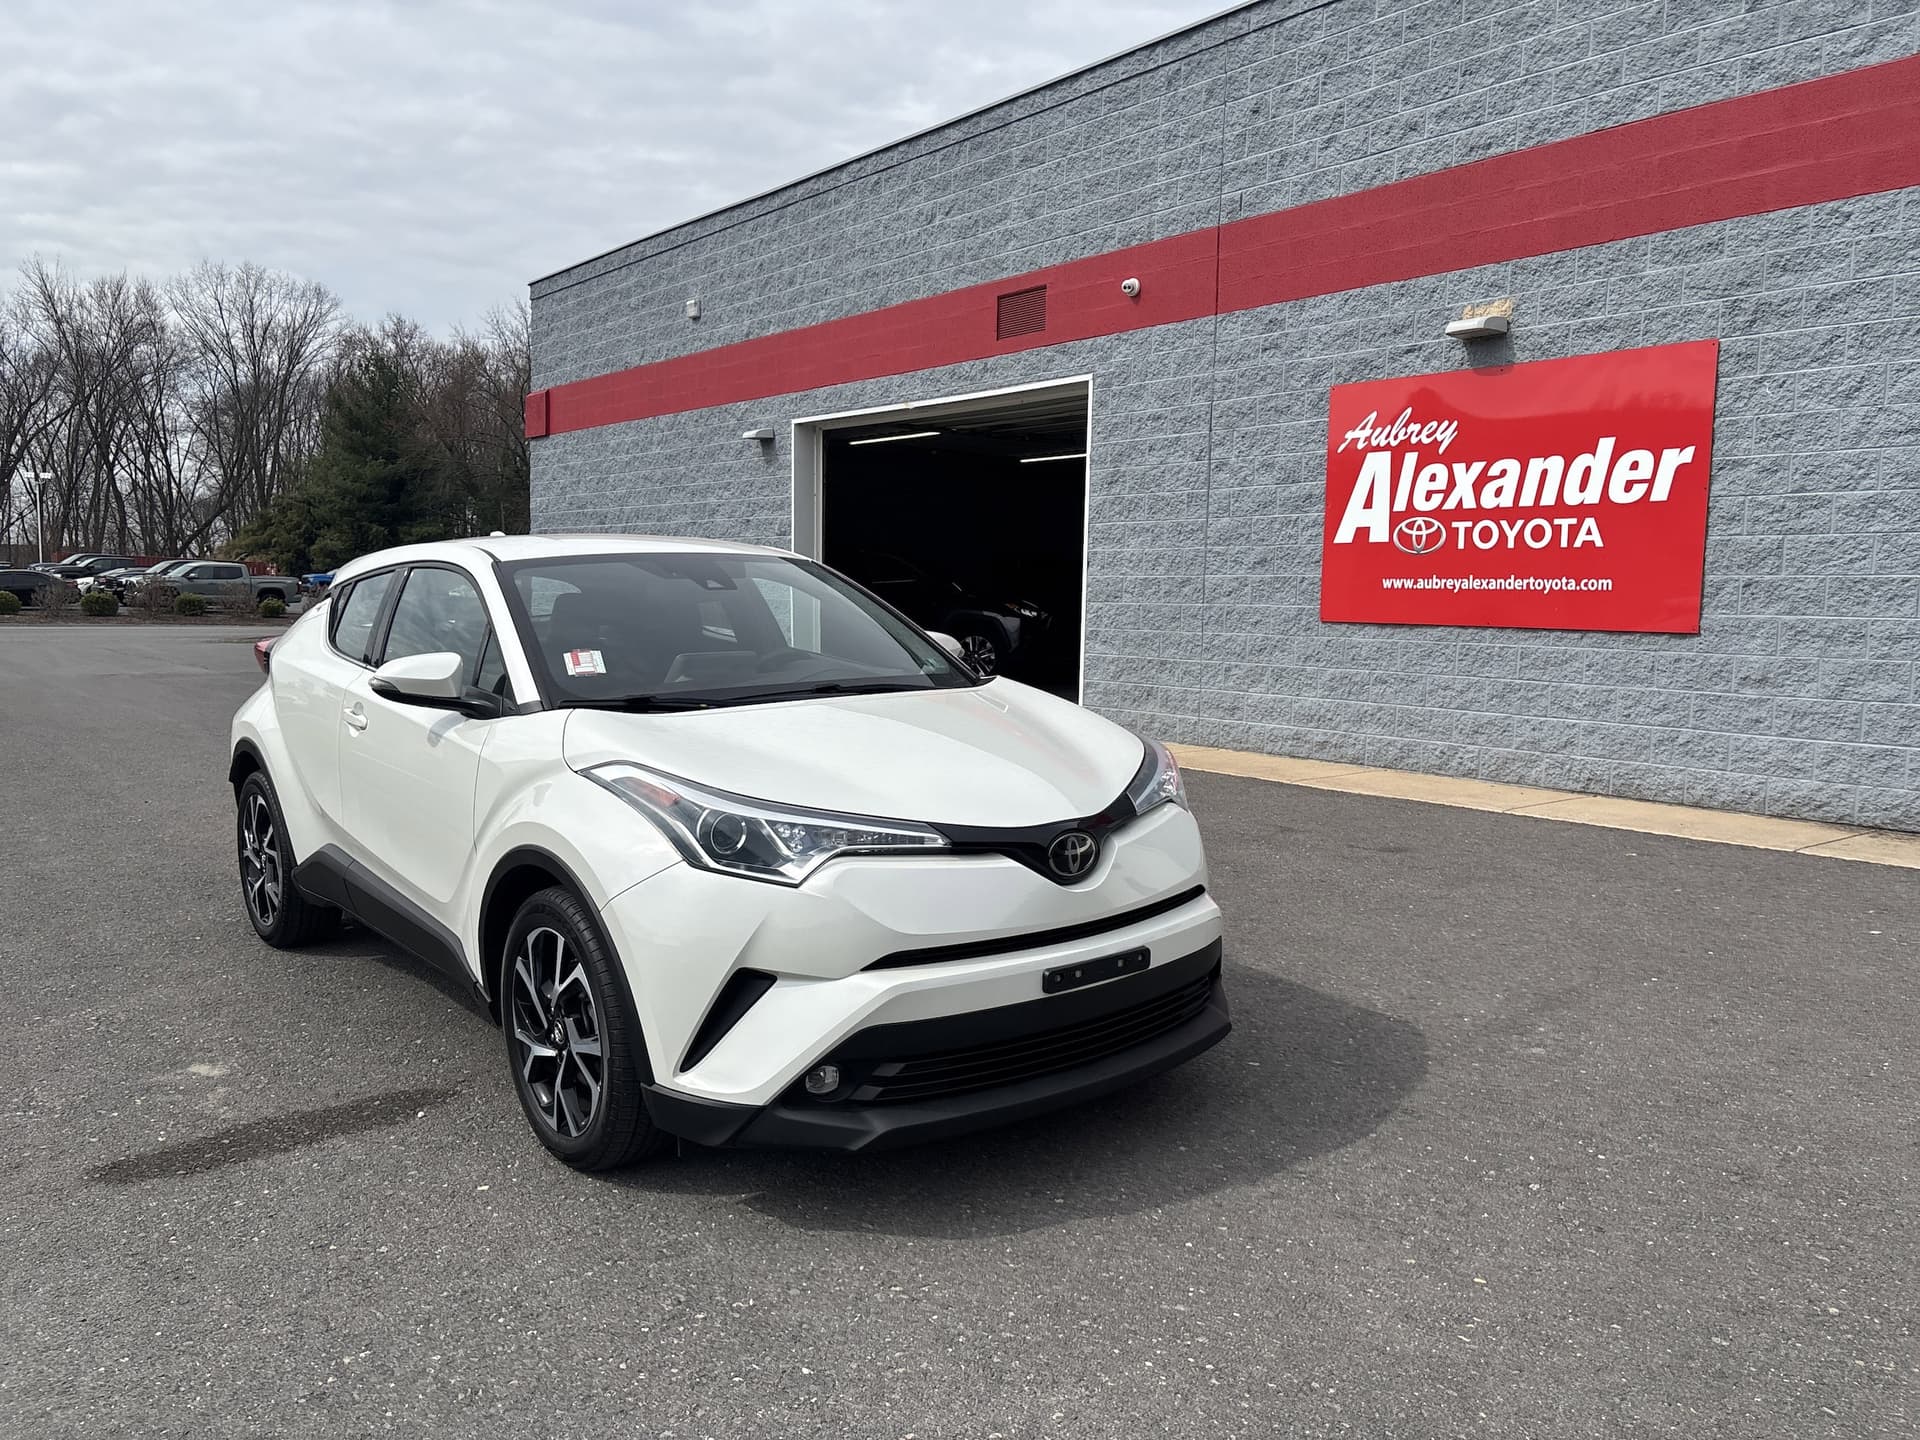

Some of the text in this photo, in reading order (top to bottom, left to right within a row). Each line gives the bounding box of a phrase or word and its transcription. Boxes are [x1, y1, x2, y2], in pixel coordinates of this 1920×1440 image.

[1337, 407, 1459, 454] Aubrey
[1333, 437, 1696, 544] Alexander
[1451, 517, 1604, 550] TOYOTA
[1382, 574, 1613, 594] www.aubreyalexandertoyota.com
